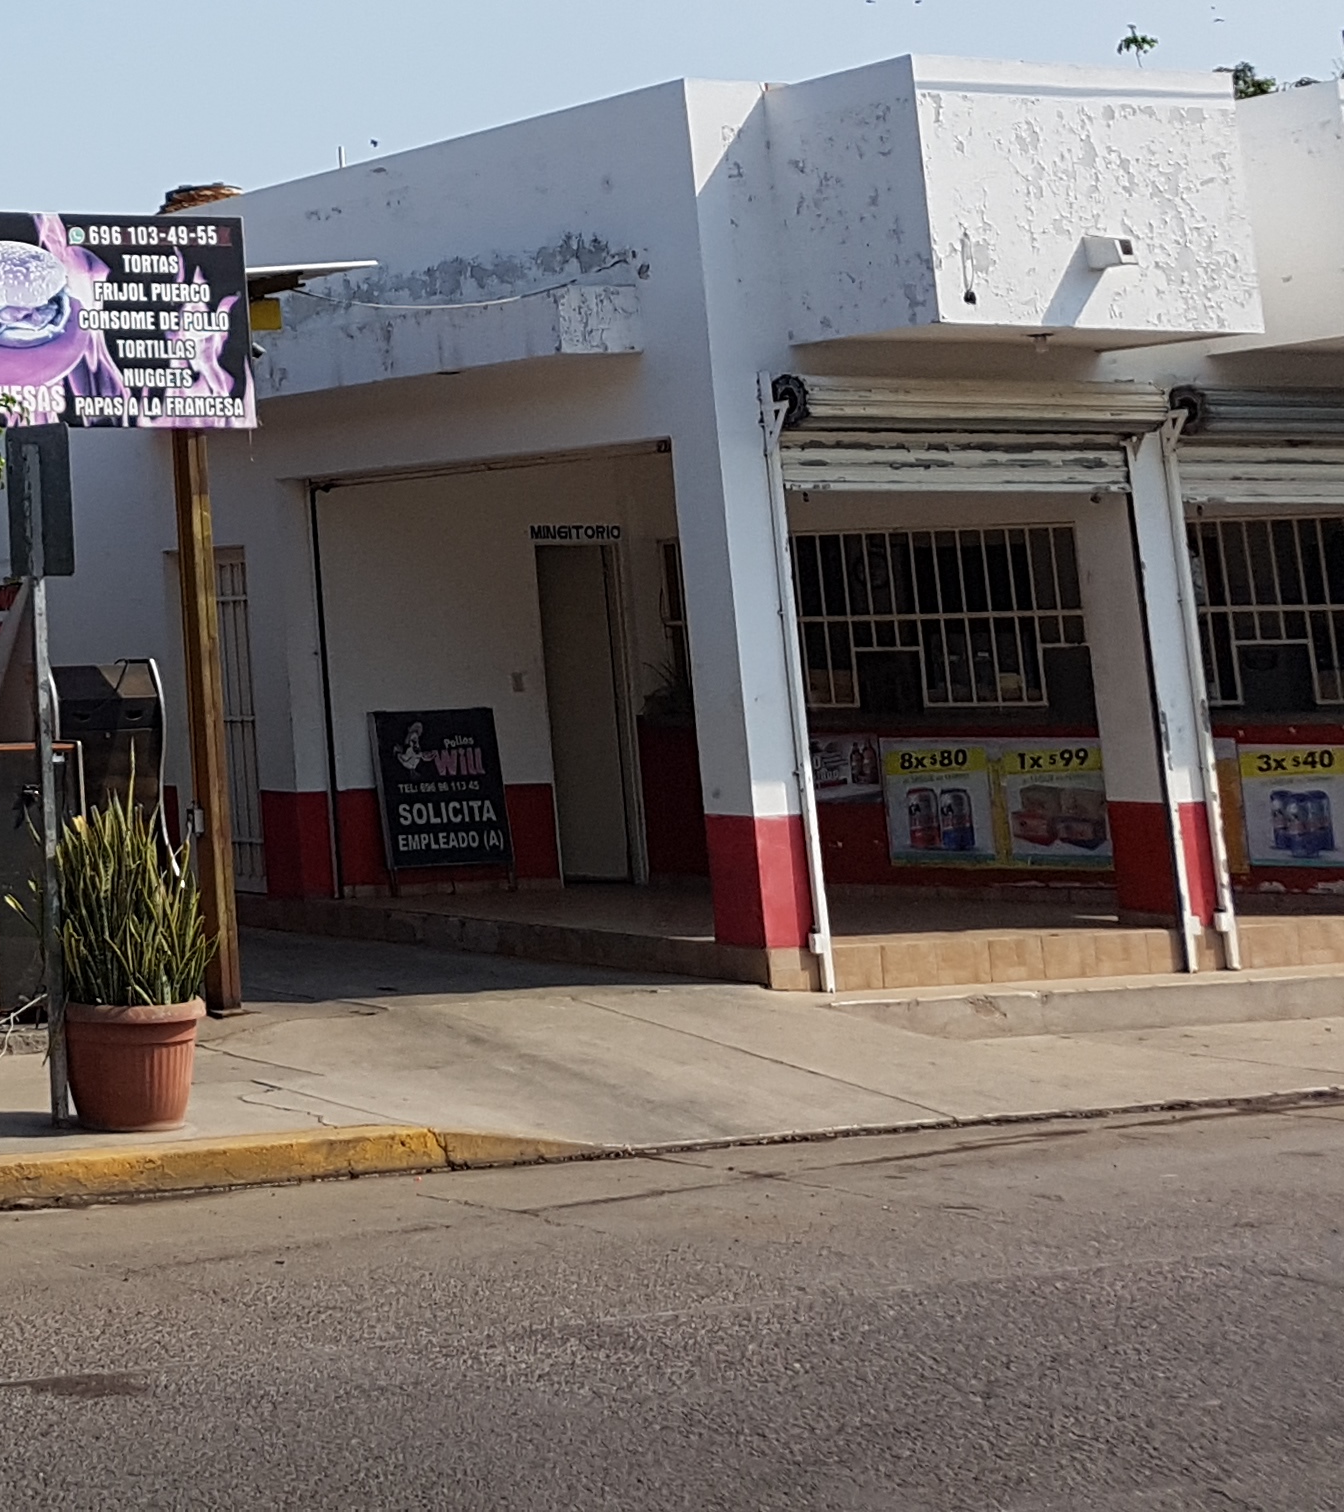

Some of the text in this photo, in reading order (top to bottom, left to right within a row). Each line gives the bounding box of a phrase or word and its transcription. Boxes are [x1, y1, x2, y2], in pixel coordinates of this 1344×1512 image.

[89, 225, 218, 246] 696 103-49-55
[122, 254, 179, 273] TORTAS
[94, 281, 211, 302] FRIJOL PUERCO
[78, 310, 229, 331] CONSOME DE POLLO
[116, 339, 195, 359] TORTILLAS
[123, 368, 193, 388] NUGGETS
[75, 396, 245, 417] PAPAS A LA FRANCESA
[529, 525, 621, 540] MINGITORIO
[443, 735, 475, 747] Pollos
[433, 747, 486, 776] Will
[398, 799, 497, 826] SOLICITA
[397, 828, 505, 852] EMPLEADO (A)
